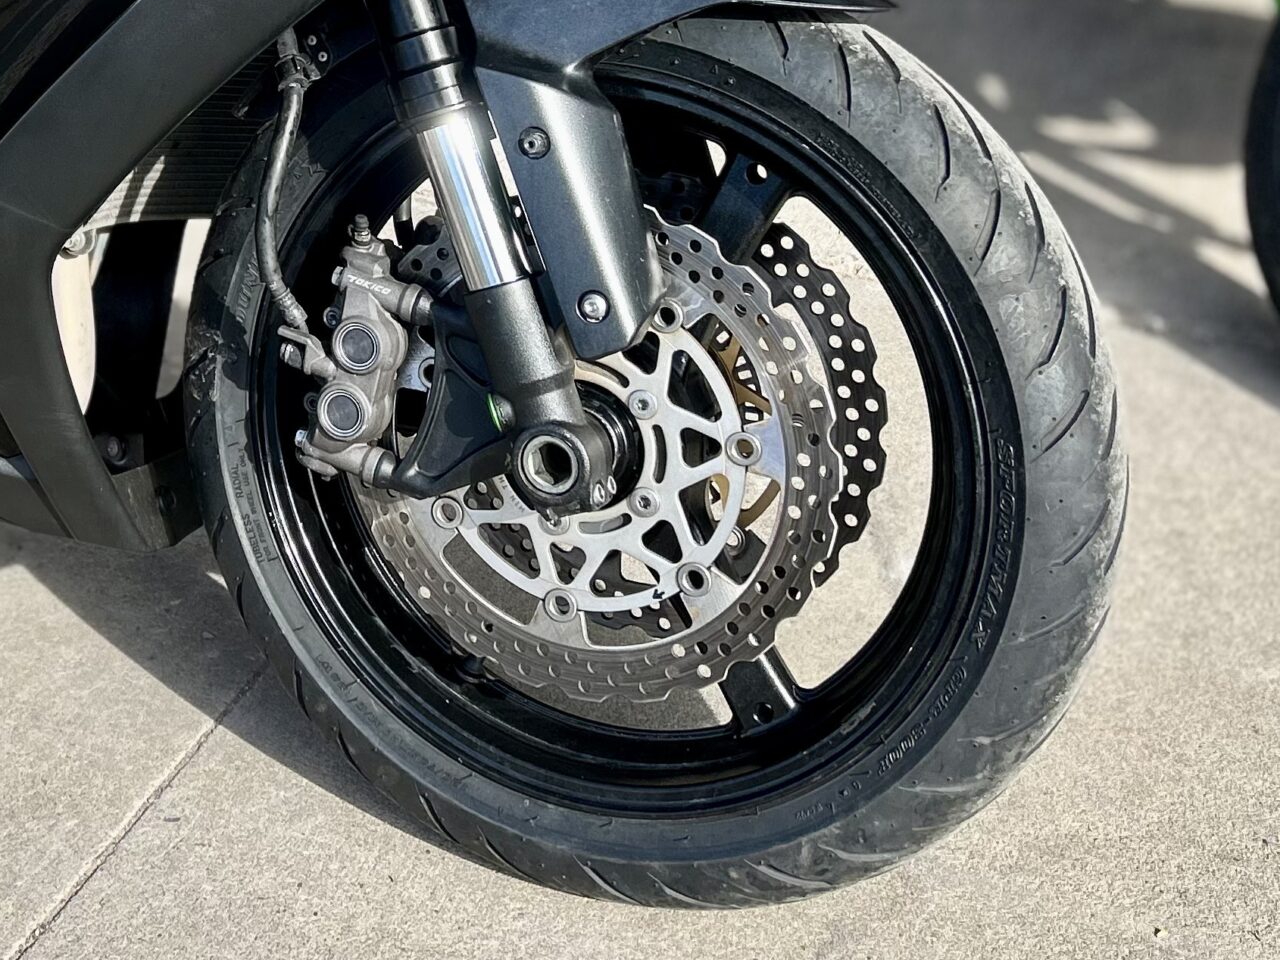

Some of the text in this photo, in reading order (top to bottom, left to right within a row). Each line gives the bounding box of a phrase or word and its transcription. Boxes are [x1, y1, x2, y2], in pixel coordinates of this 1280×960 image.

[347, 274, 392, 295] TOKICO
[231, 463, 244, 499] RADIAL
[242, 513, 265, 564] TUBELESS
